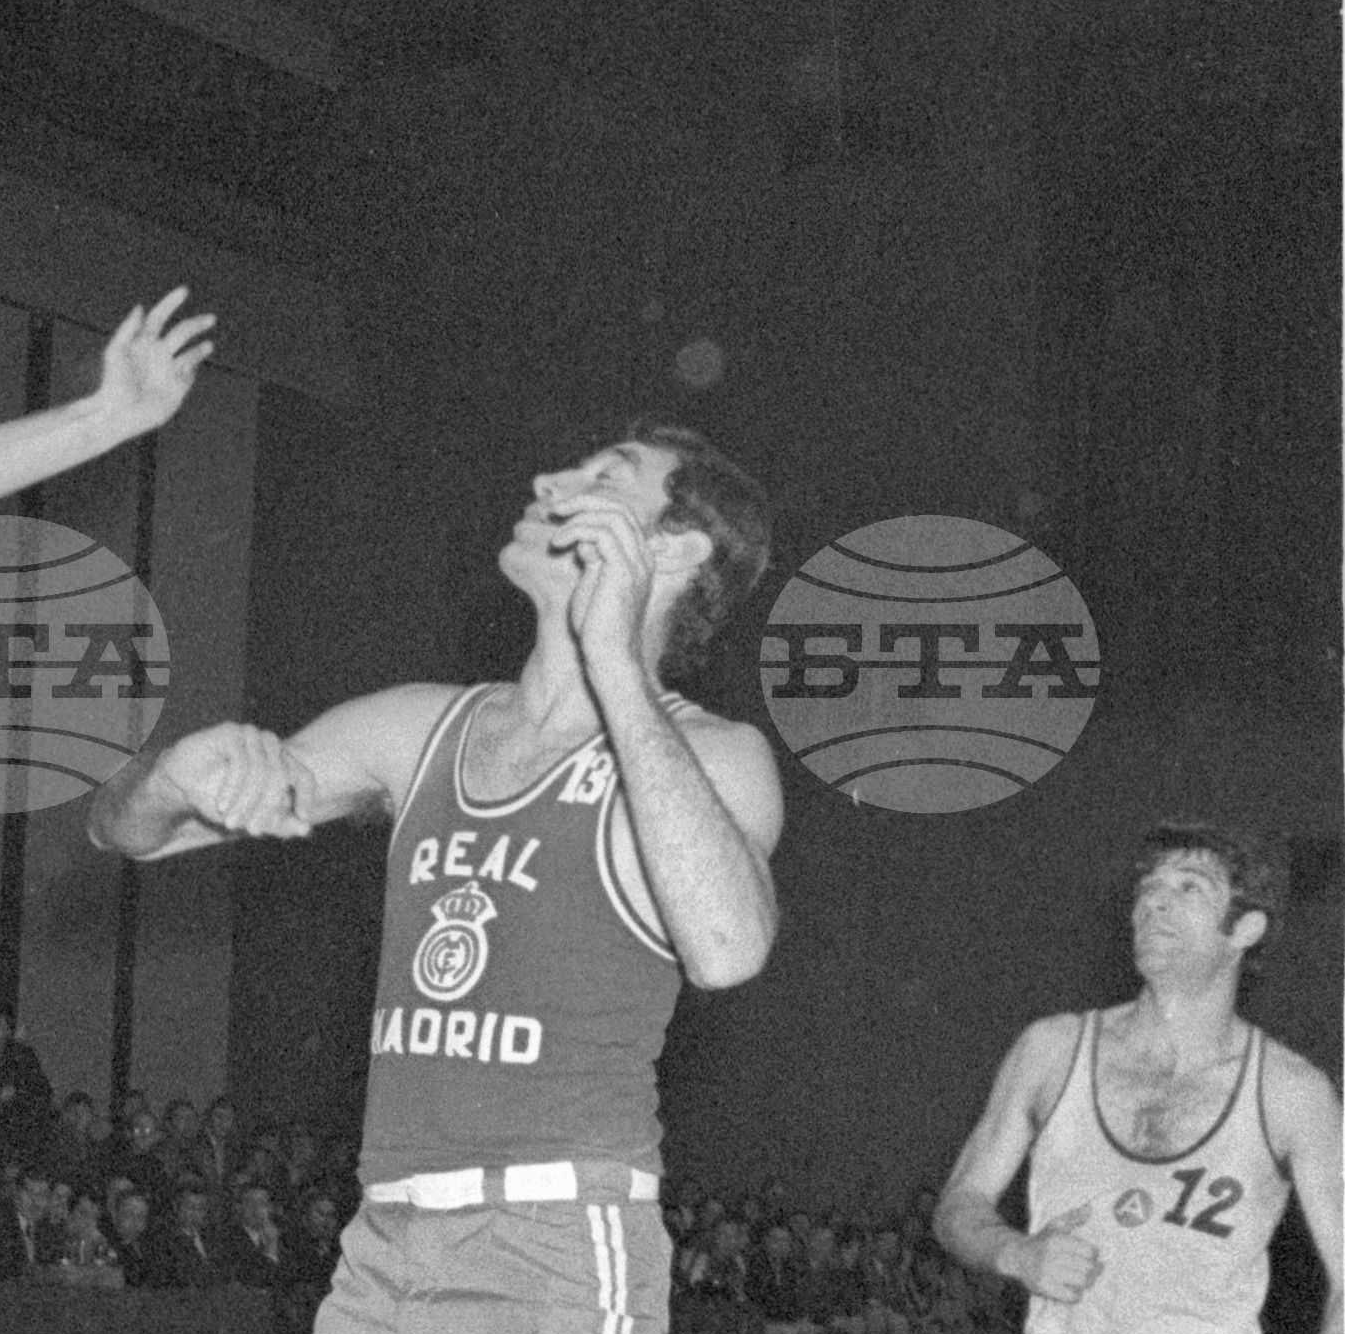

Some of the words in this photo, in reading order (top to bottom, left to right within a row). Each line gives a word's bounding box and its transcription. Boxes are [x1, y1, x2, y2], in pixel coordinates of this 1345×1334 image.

[556, 747, 614, 806] 13
[408, 831, 541, 893] REAL
[1162, 1167, 1244, 1239] 12
